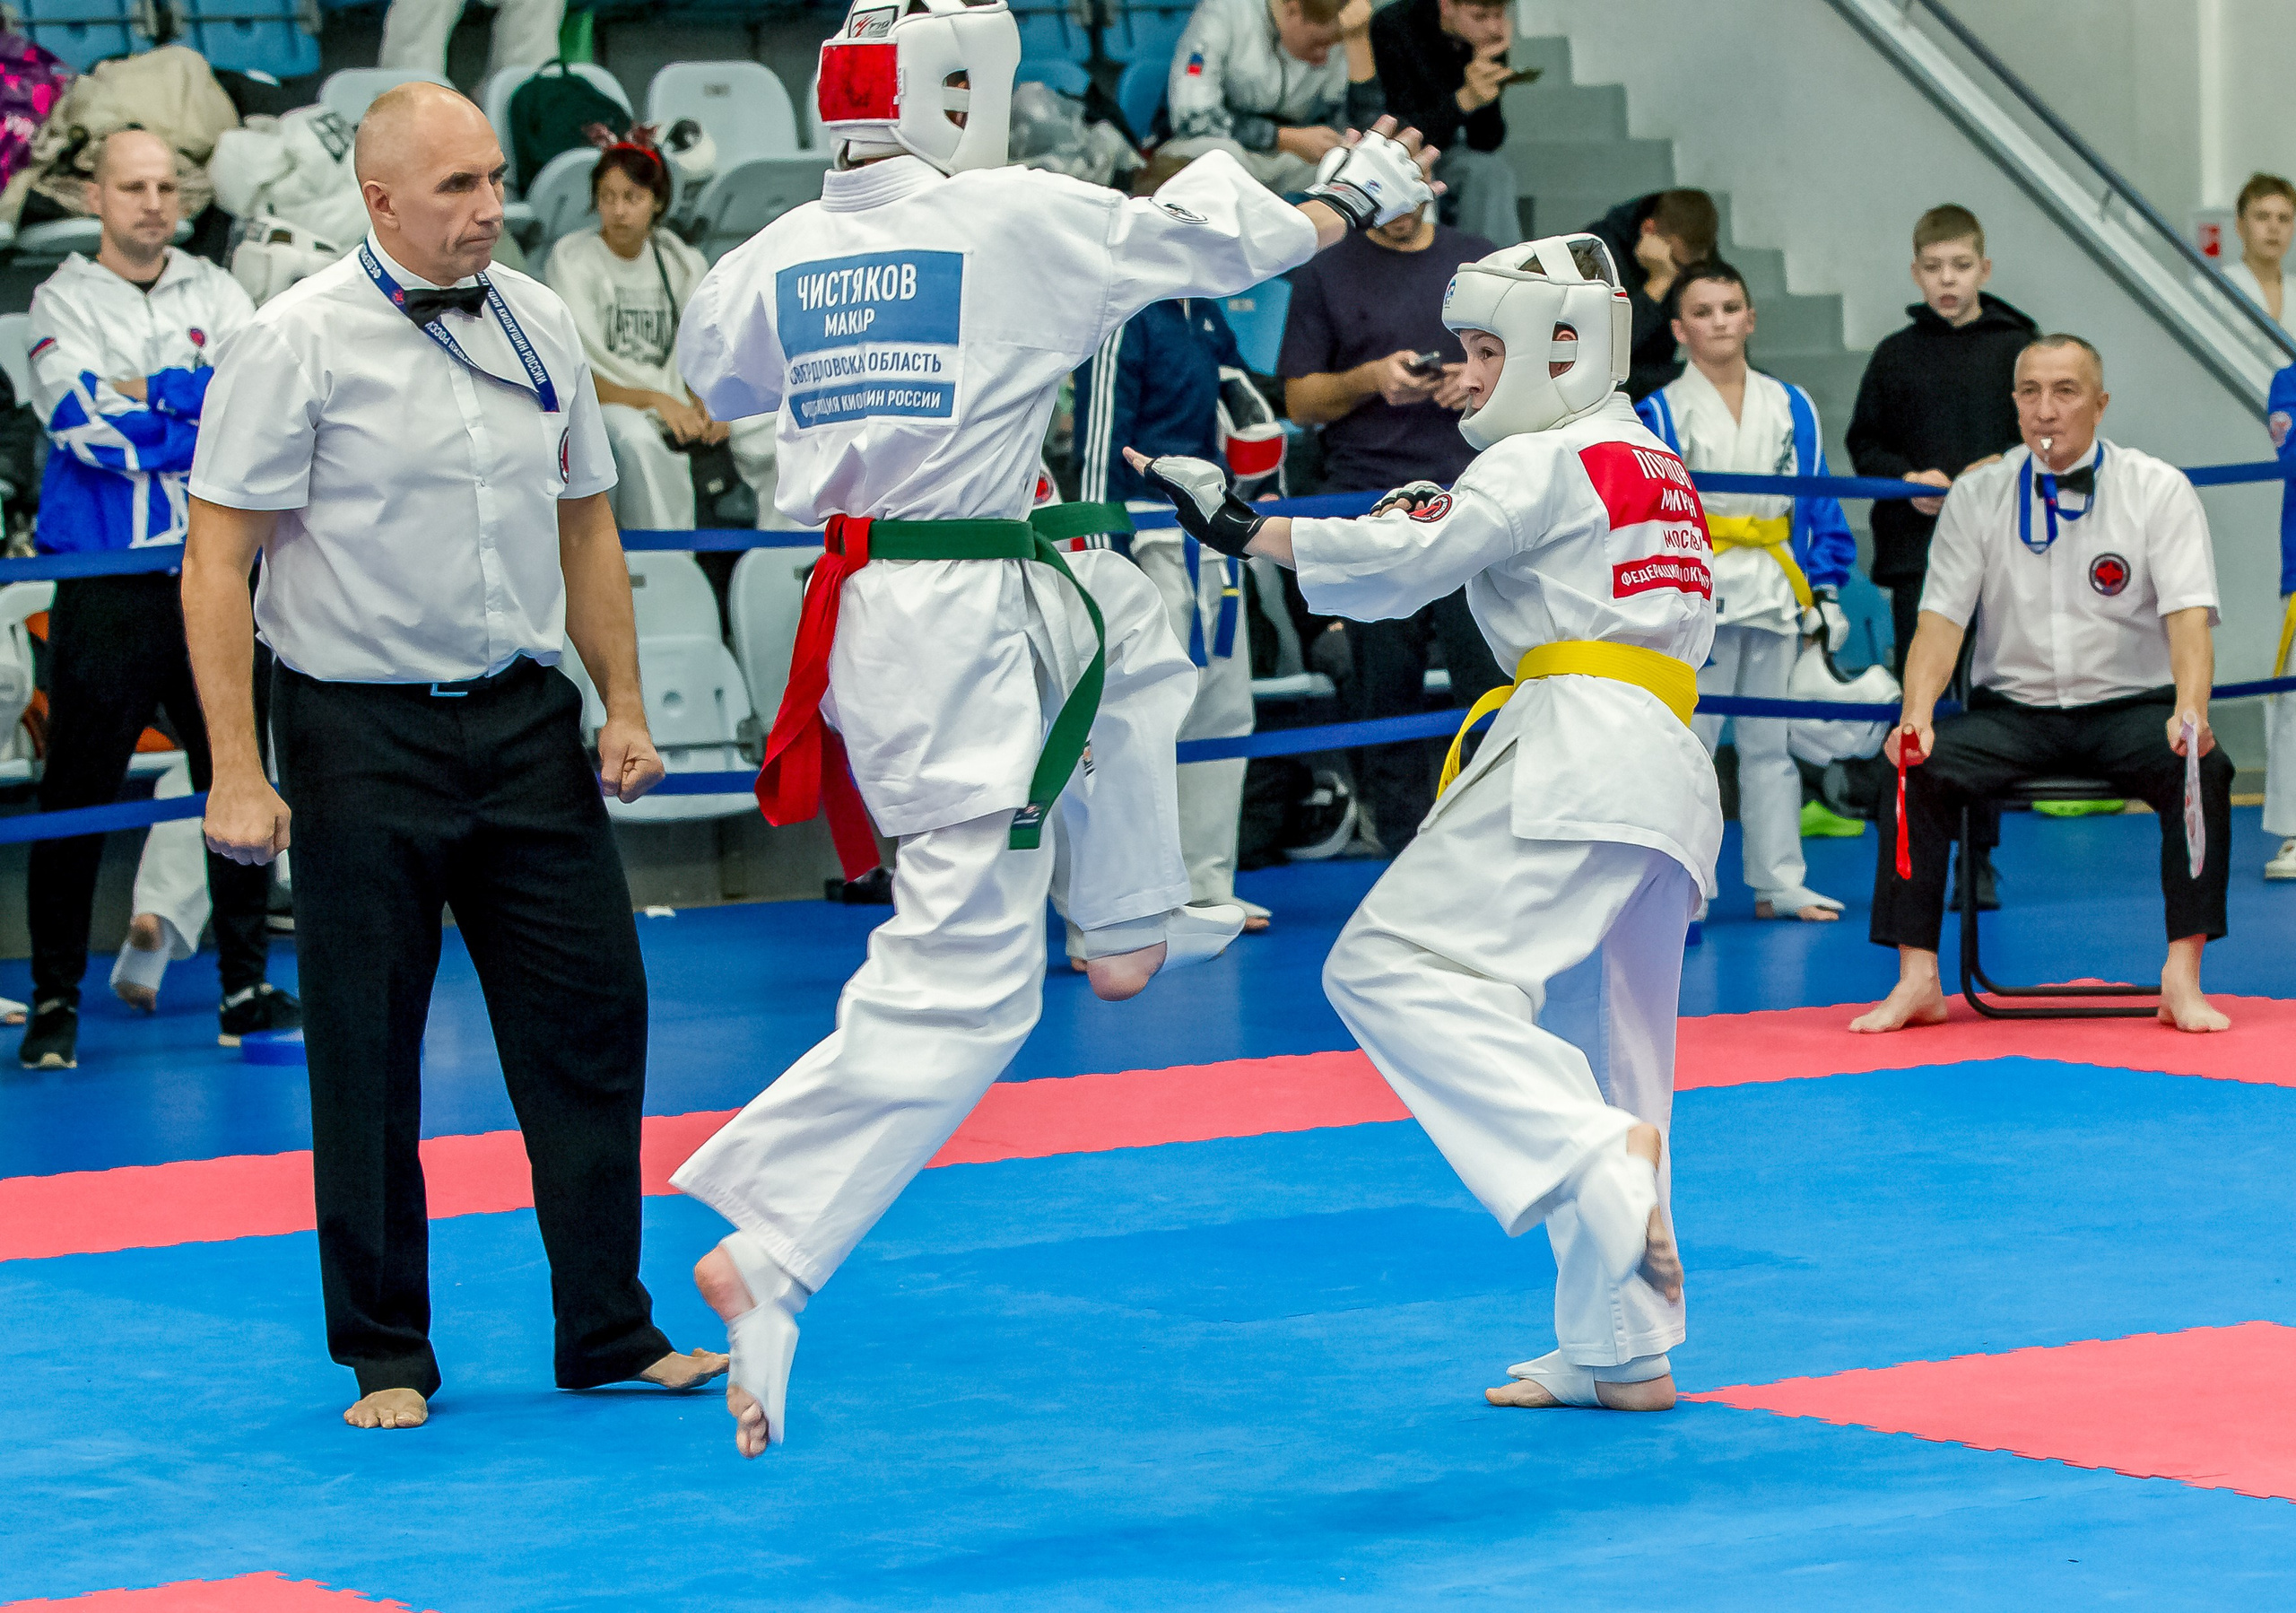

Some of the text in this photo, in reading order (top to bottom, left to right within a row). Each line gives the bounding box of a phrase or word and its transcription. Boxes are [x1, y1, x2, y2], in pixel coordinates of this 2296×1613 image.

[796, 263, 918, 311] ЧИСТЯКОВ
[497, 306, 529, 353] КИОКУШИН
[521, 352, 548, 386] РОССИИ
[867, 352, 943, 374] ОБЛАСТЬ
[887, 388, 942, 409] РОССИИ
